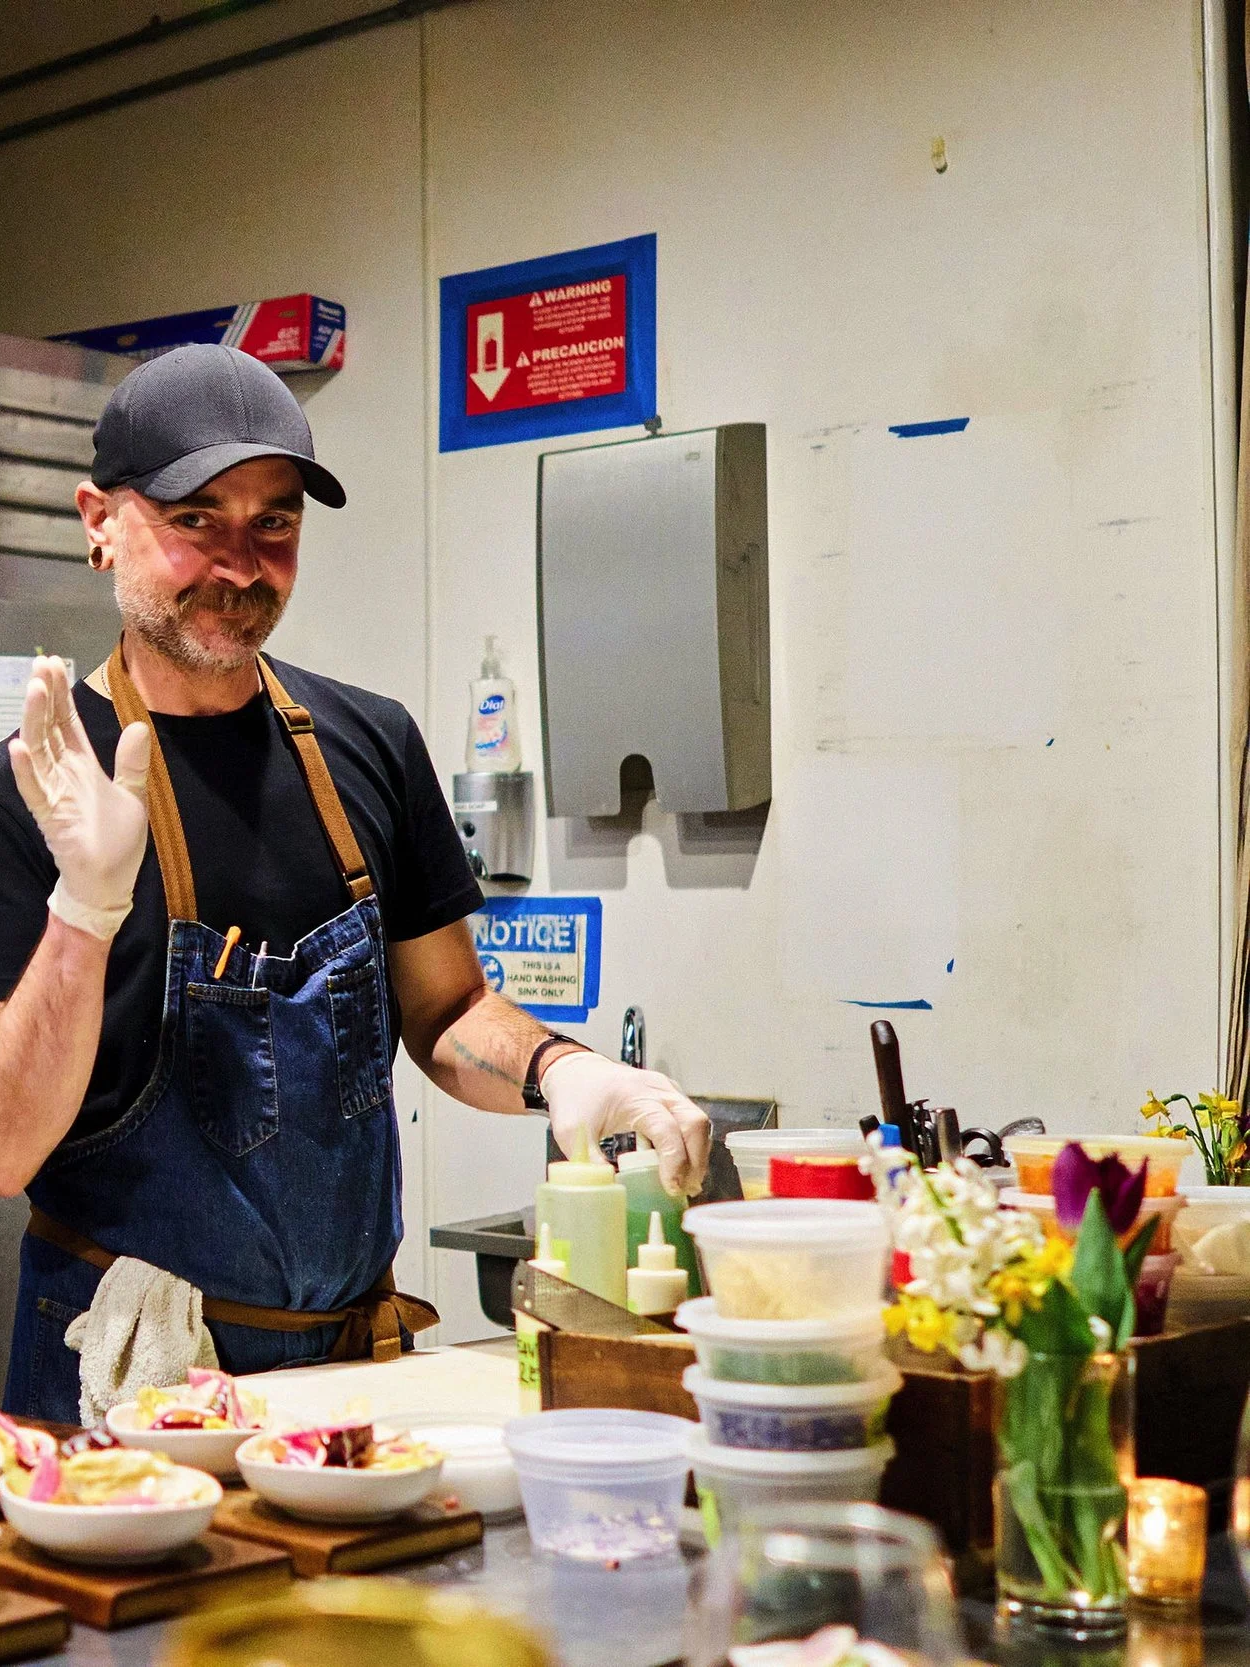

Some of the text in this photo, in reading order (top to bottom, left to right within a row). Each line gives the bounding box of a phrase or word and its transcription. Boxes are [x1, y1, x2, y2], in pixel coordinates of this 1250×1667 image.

[544, 279, 612, 304] WARNING
[532, 335, 624, 364] PRECAUCION
[481, 699, 504, 710] Dial
[472, 920, 571, 948] NOTICE
[522, 960, 561, 971] THIS IS A
[506, 973, 577, 985] HAND WASHING
[517, 987, 566, 998] SINK ONLY
